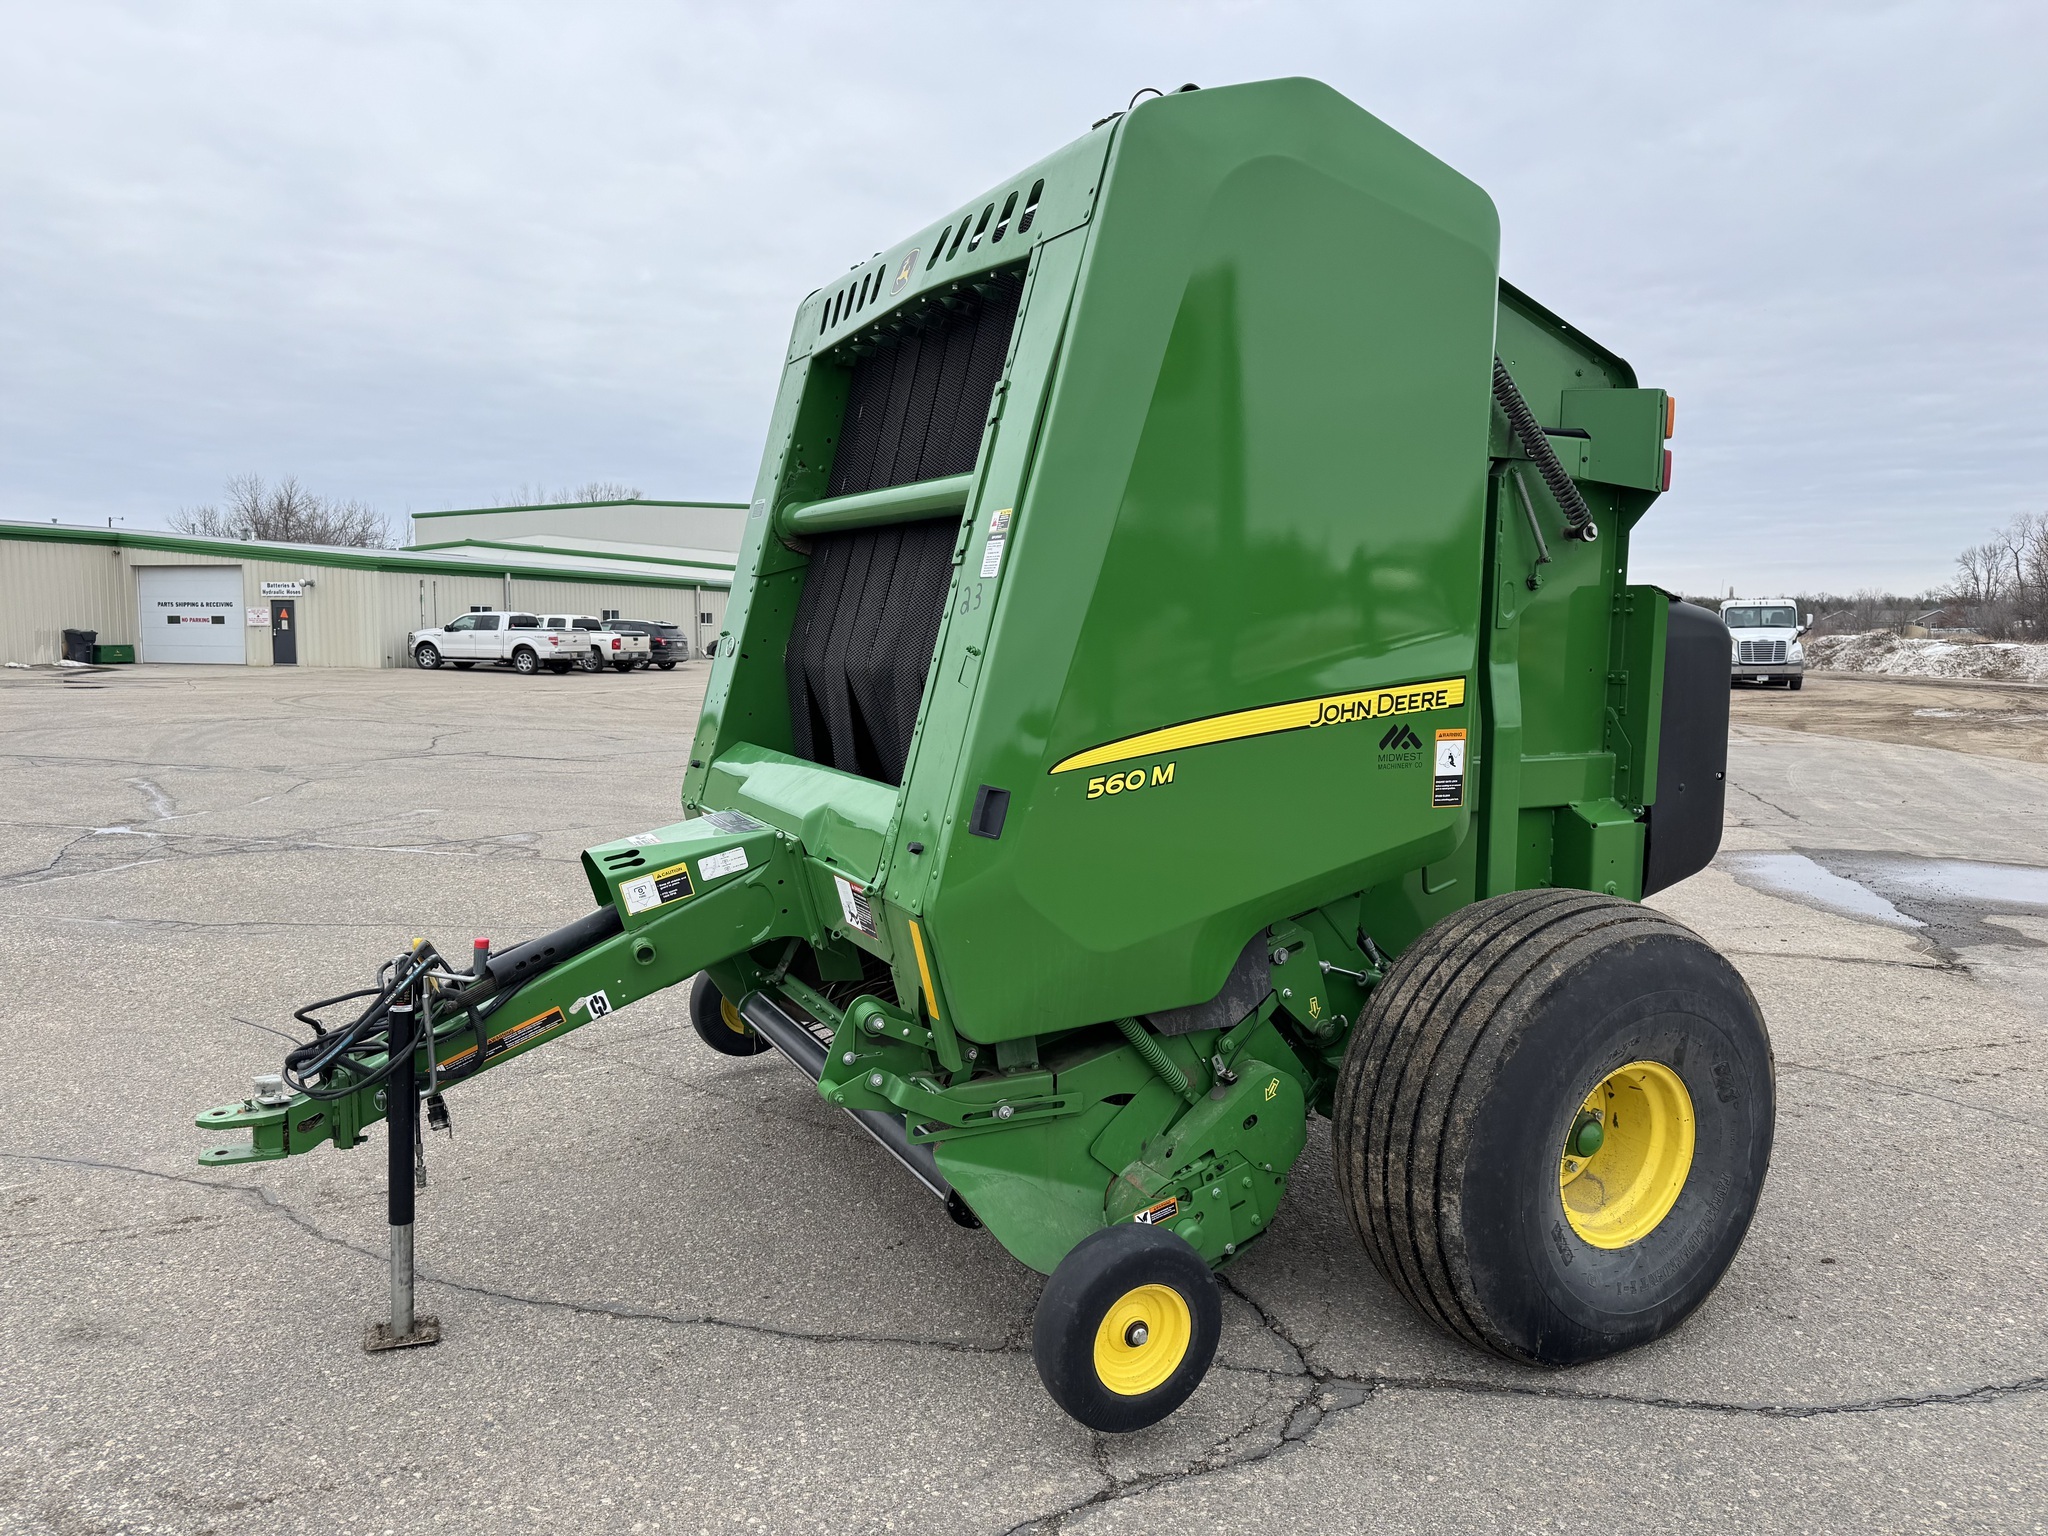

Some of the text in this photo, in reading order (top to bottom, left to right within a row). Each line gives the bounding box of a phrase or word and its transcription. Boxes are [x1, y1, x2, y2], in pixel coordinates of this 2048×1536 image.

[960, 582, 983, 615] 23
[1309, 689, 1449, 725] JOHN DEERE
[1377, 752, 1424, 763] MIDWEST
[1377, 762, 1413, 770] MACHINERY
[1086, 761, 1177, 800] 560 M
